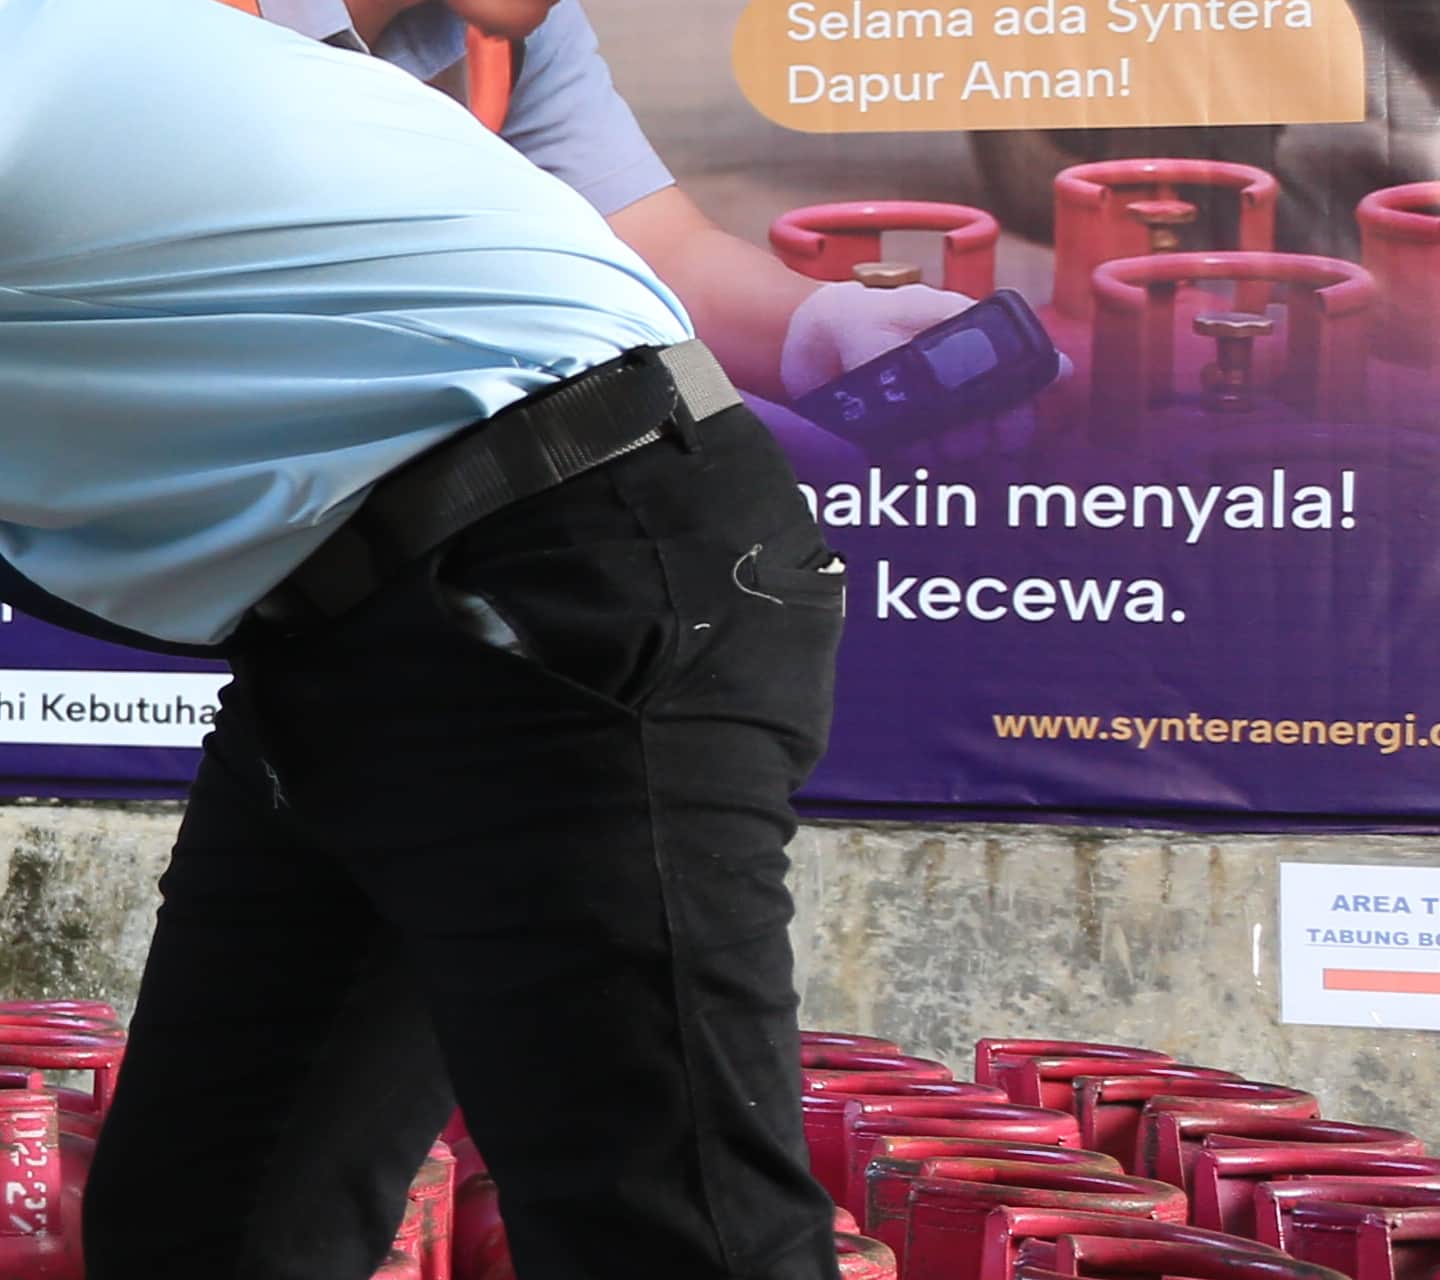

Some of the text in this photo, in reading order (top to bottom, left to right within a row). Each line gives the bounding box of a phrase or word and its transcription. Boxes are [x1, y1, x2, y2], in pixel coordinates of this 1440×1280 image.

[786, 0, 974, 42] Selama
[787, 56, 1132, 112] Dapur Aman!
[1007, 468, 1358, 544] menyala!
[875, 560, 1187, 624] kecewa.
[1331, 894, 1411, 914] AREA
[1306, 928, 1410, 946] TABUNG
